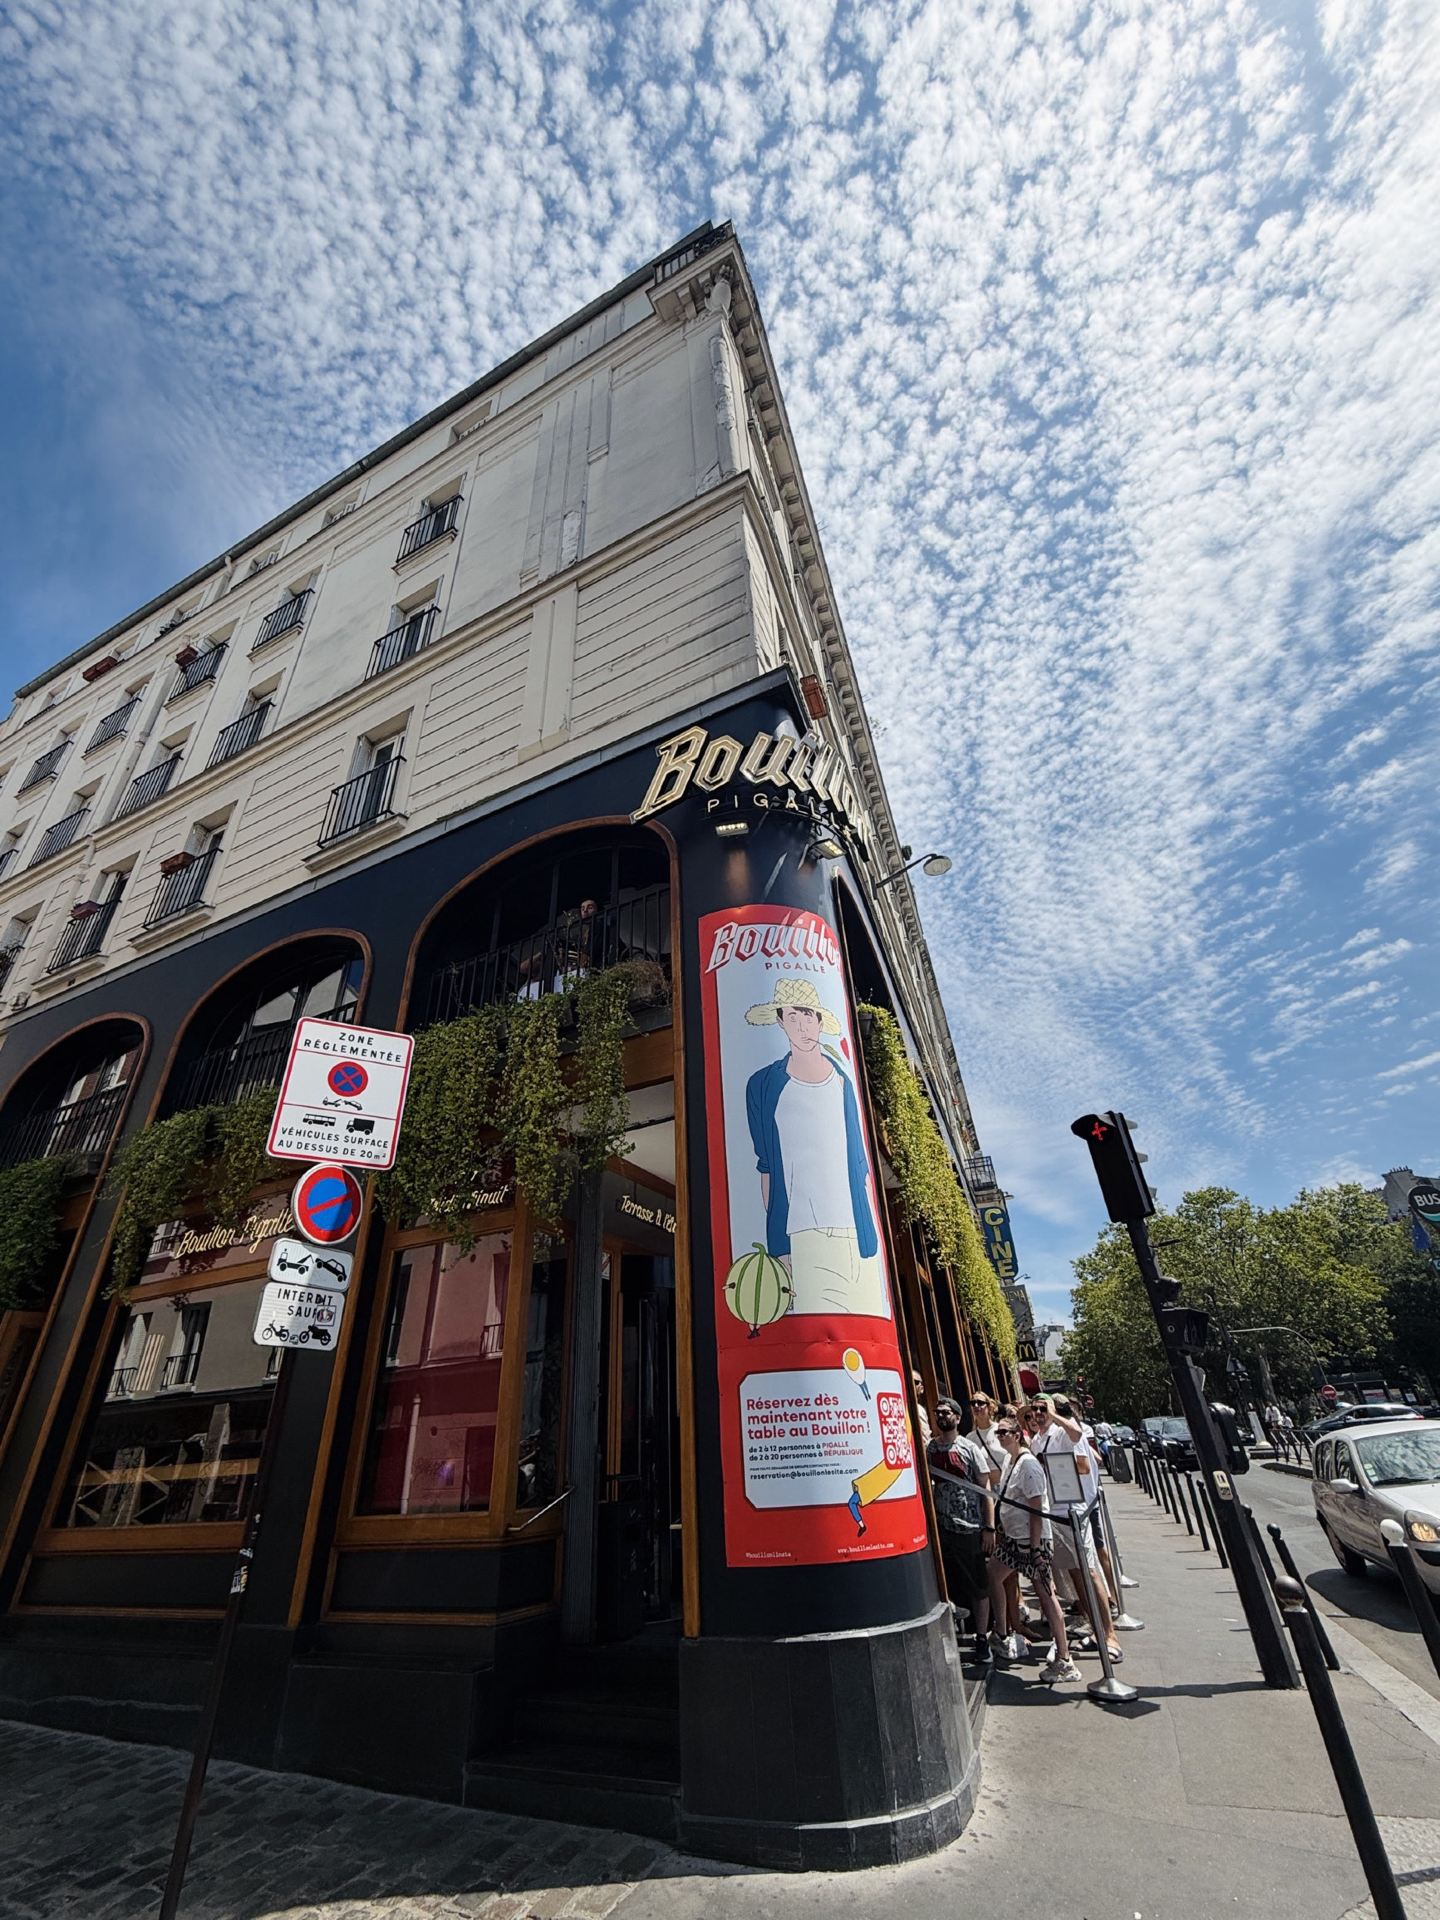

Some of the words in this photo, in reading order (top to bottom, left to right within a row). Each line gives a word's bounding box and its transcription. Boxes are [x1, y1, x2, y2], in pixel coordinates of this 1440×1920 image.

[765, 962, 826, 974] PIGALLE
[339, 1032, 375, 1046] ZONE
[304, 1038, 402, 1062] RÉGLEMENTÉE
[281, 1126, 340, 1142] VÉHICULES
[343, 1135, 389, 1149] SURFACE
[277, 1140, 292, 1149] AU
[296, 1141, 339, 1155] DESSUS
[342, 1148, 355, 1156] DE
[1414, 1193, 1440, 1207] BUS
[621, 1195, 654, 1223] Terrasse
[174, 1224, 236, 1259] Bouillon
[278, 1288, 333, 1306] INTERDIT
[746, 1396, 811, 1411] Réservez
[814, 1393, 839, 1406] dès
[747, 1409, 833, 1425] maintenant
[834, 1408, 867, 1420] votre
[748, 1425, 786, 1440] table
[789, 1427, 808, 1437] au
[812, 1421, 865, 1436] Bouillon
[764, 1444, 769, 1452] à
[778, 1443, 815, 1453] personnes
[816, 1442, 821, 1450] à
[821, 1441, 849, 1449] PIGALLE
[764, 1452, 769, 1460] à
[780, 1451, 817, 1461] personnes
[824, 1448, 863, 1457] RÉPUBLIQUE
